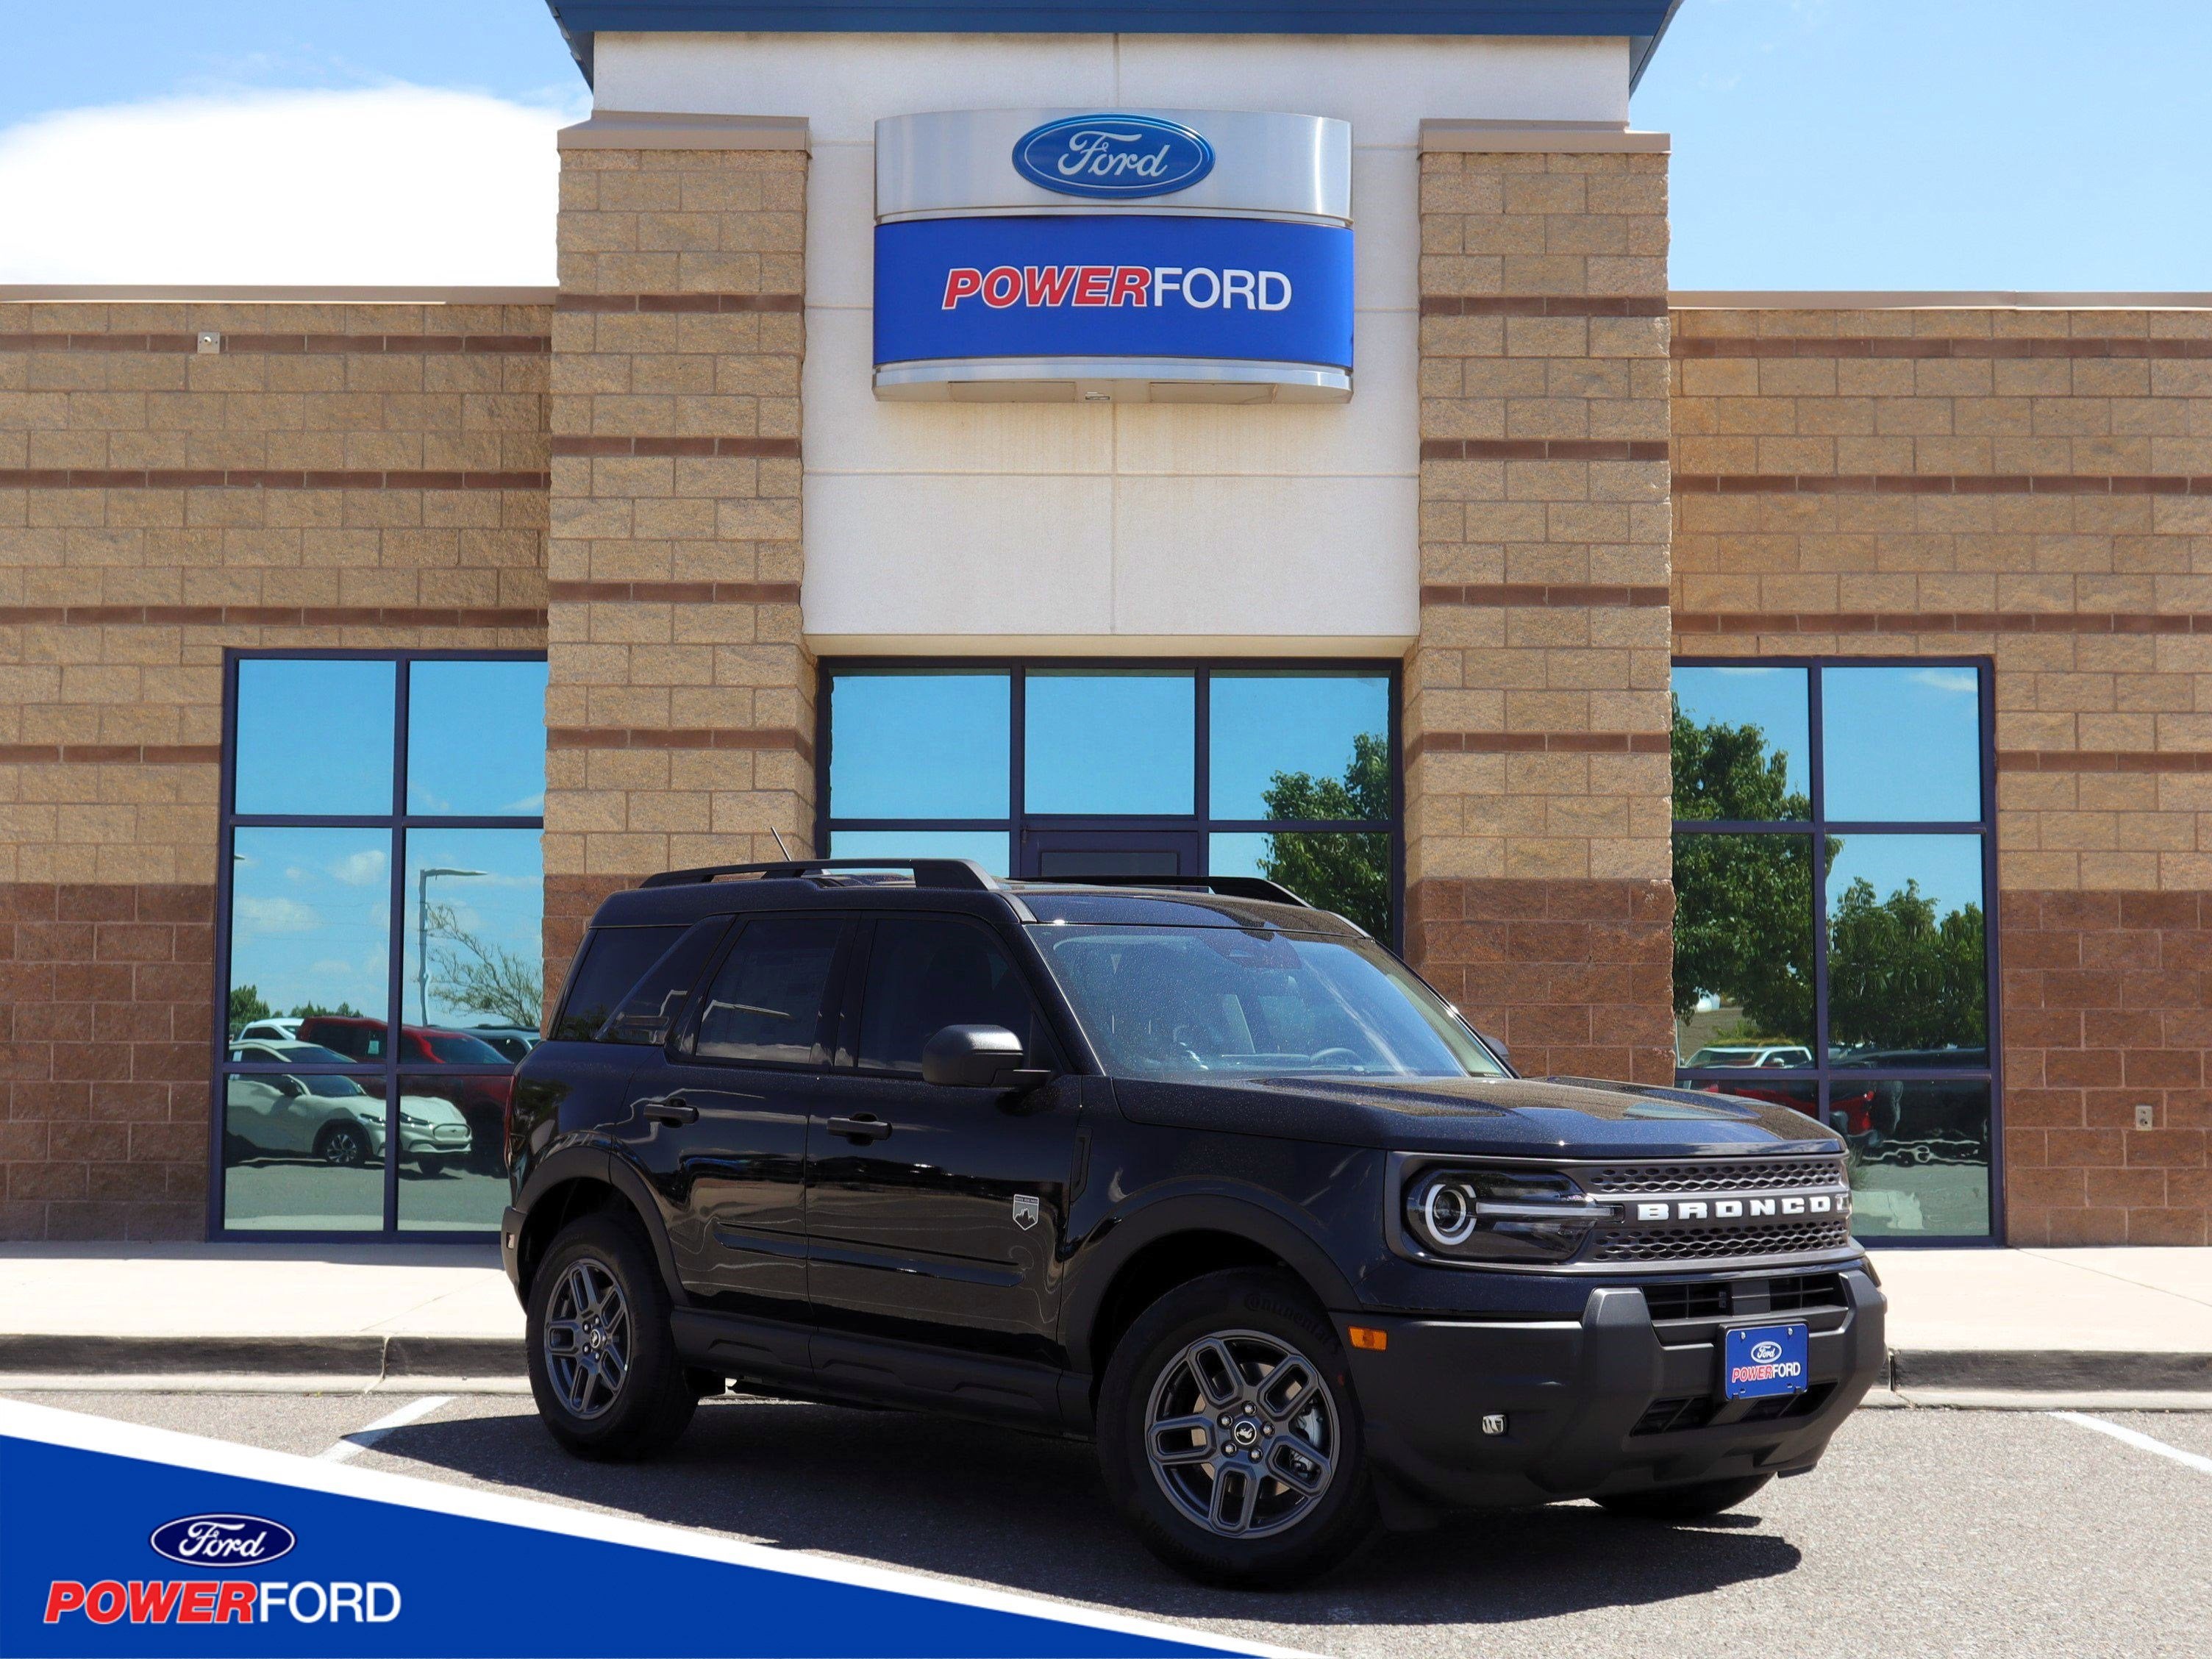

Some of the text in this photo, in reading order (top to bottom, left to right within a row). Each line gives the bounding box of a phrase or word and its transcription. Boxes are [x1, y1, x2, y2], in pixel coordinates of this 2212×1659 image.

[1057, 130, 1171, 177] Ford
[942, 265, 1292, 311] POWERFORD
[1637, 1195, 1831, 1221] BRONCO
[1757, 1345, 1776, 1359] Ford
[1732, 1361, 1802, 1384] POWERFORD
